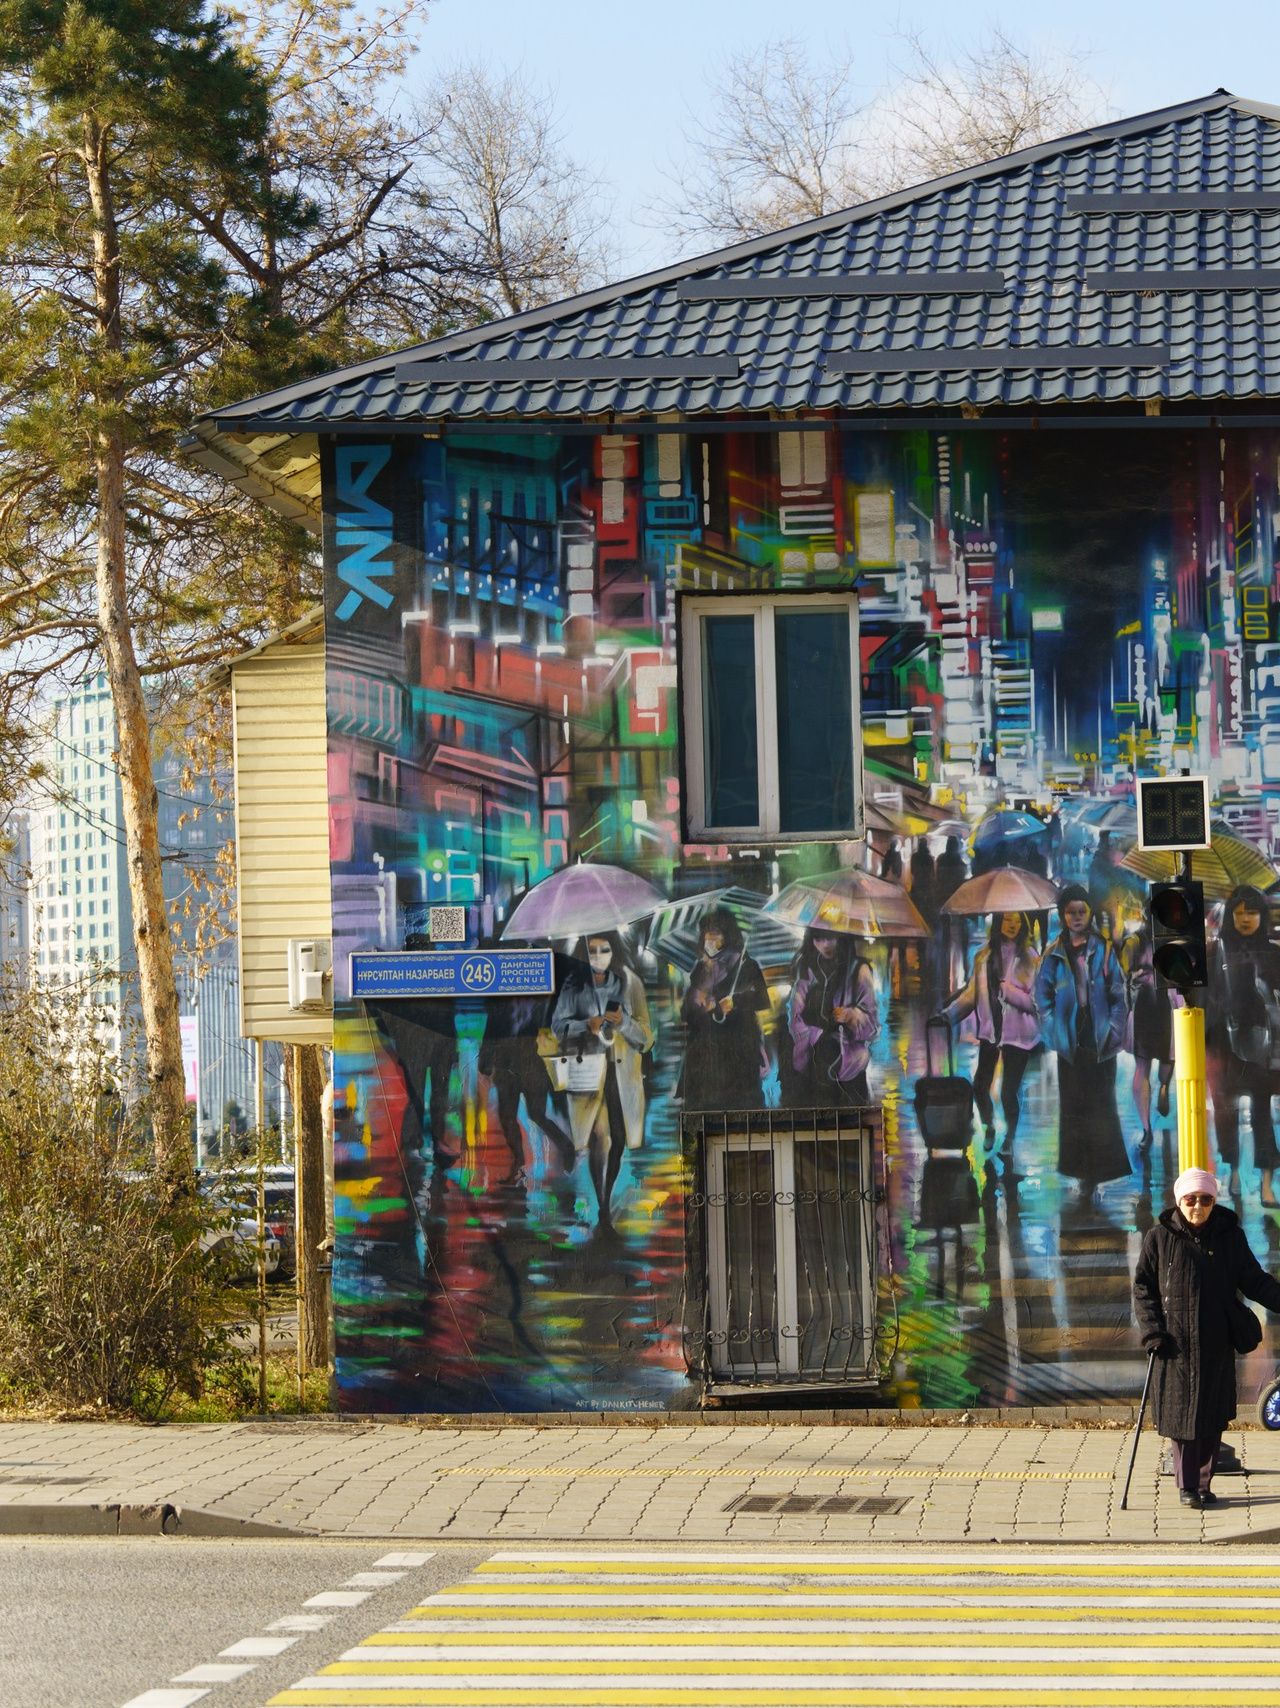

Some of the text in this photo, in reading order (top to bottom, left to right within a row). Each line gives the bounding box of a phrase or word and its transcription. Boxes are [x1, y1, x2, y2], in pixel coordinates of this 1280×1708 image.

[357, 968, 455, 981] НҰРСҰЛТАН НАЗАРБАЕВ
[465, 963, 491, 983] 245
[576, 1400, 589, 1408] ART
